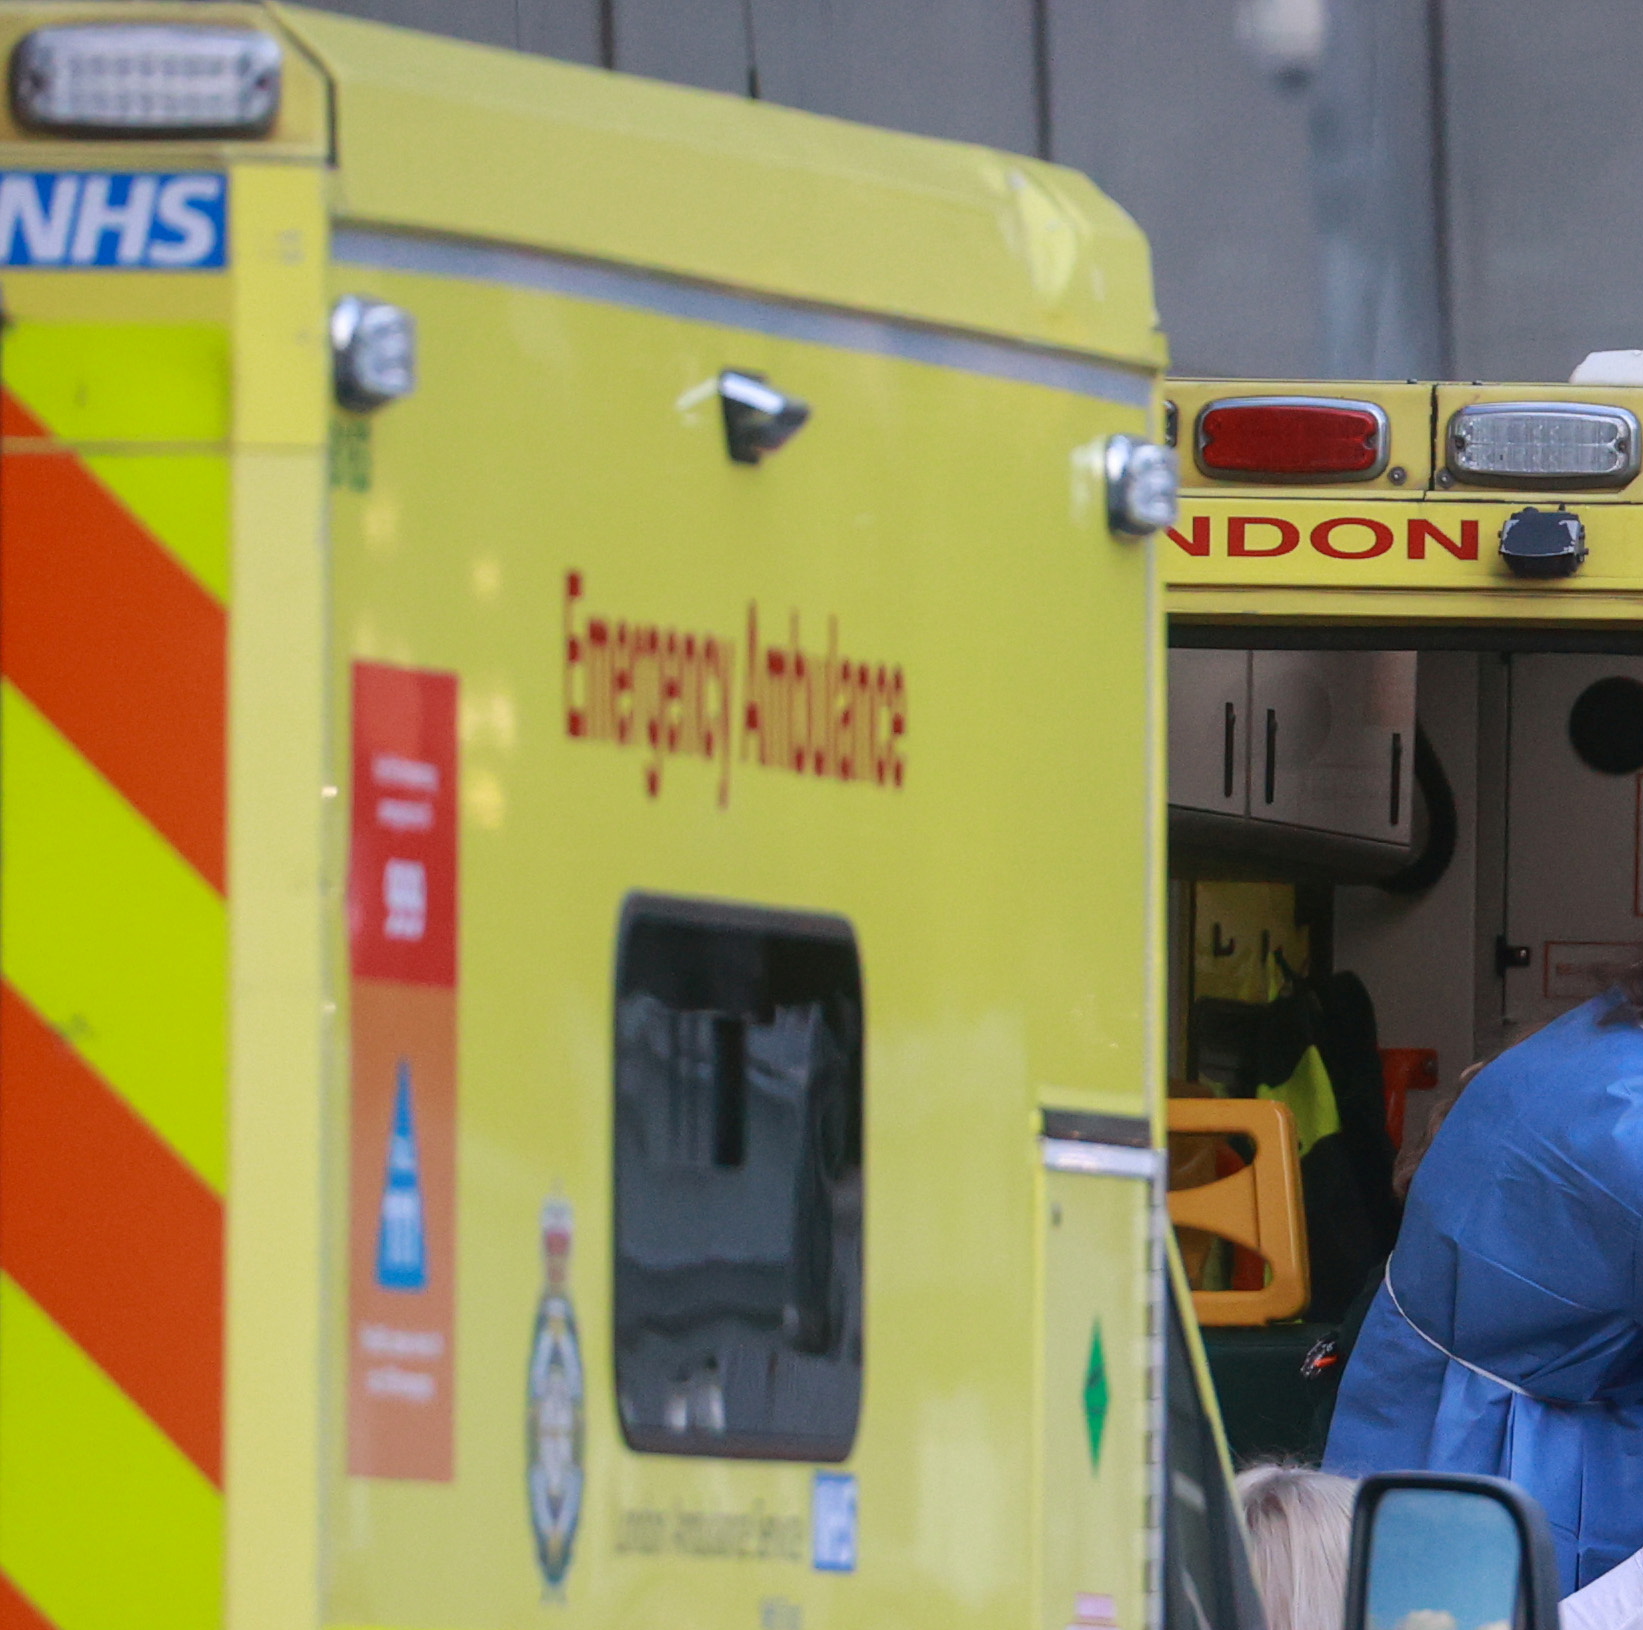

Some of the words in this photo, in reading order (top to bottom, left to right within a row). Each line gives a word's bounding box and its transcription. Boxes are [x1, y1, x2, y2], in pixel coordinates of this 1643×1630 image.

[0, 172, 220, 267] NHS
[564, 567, 736, 812] Emergency
[740, 597, 908, 790] Ambulance
